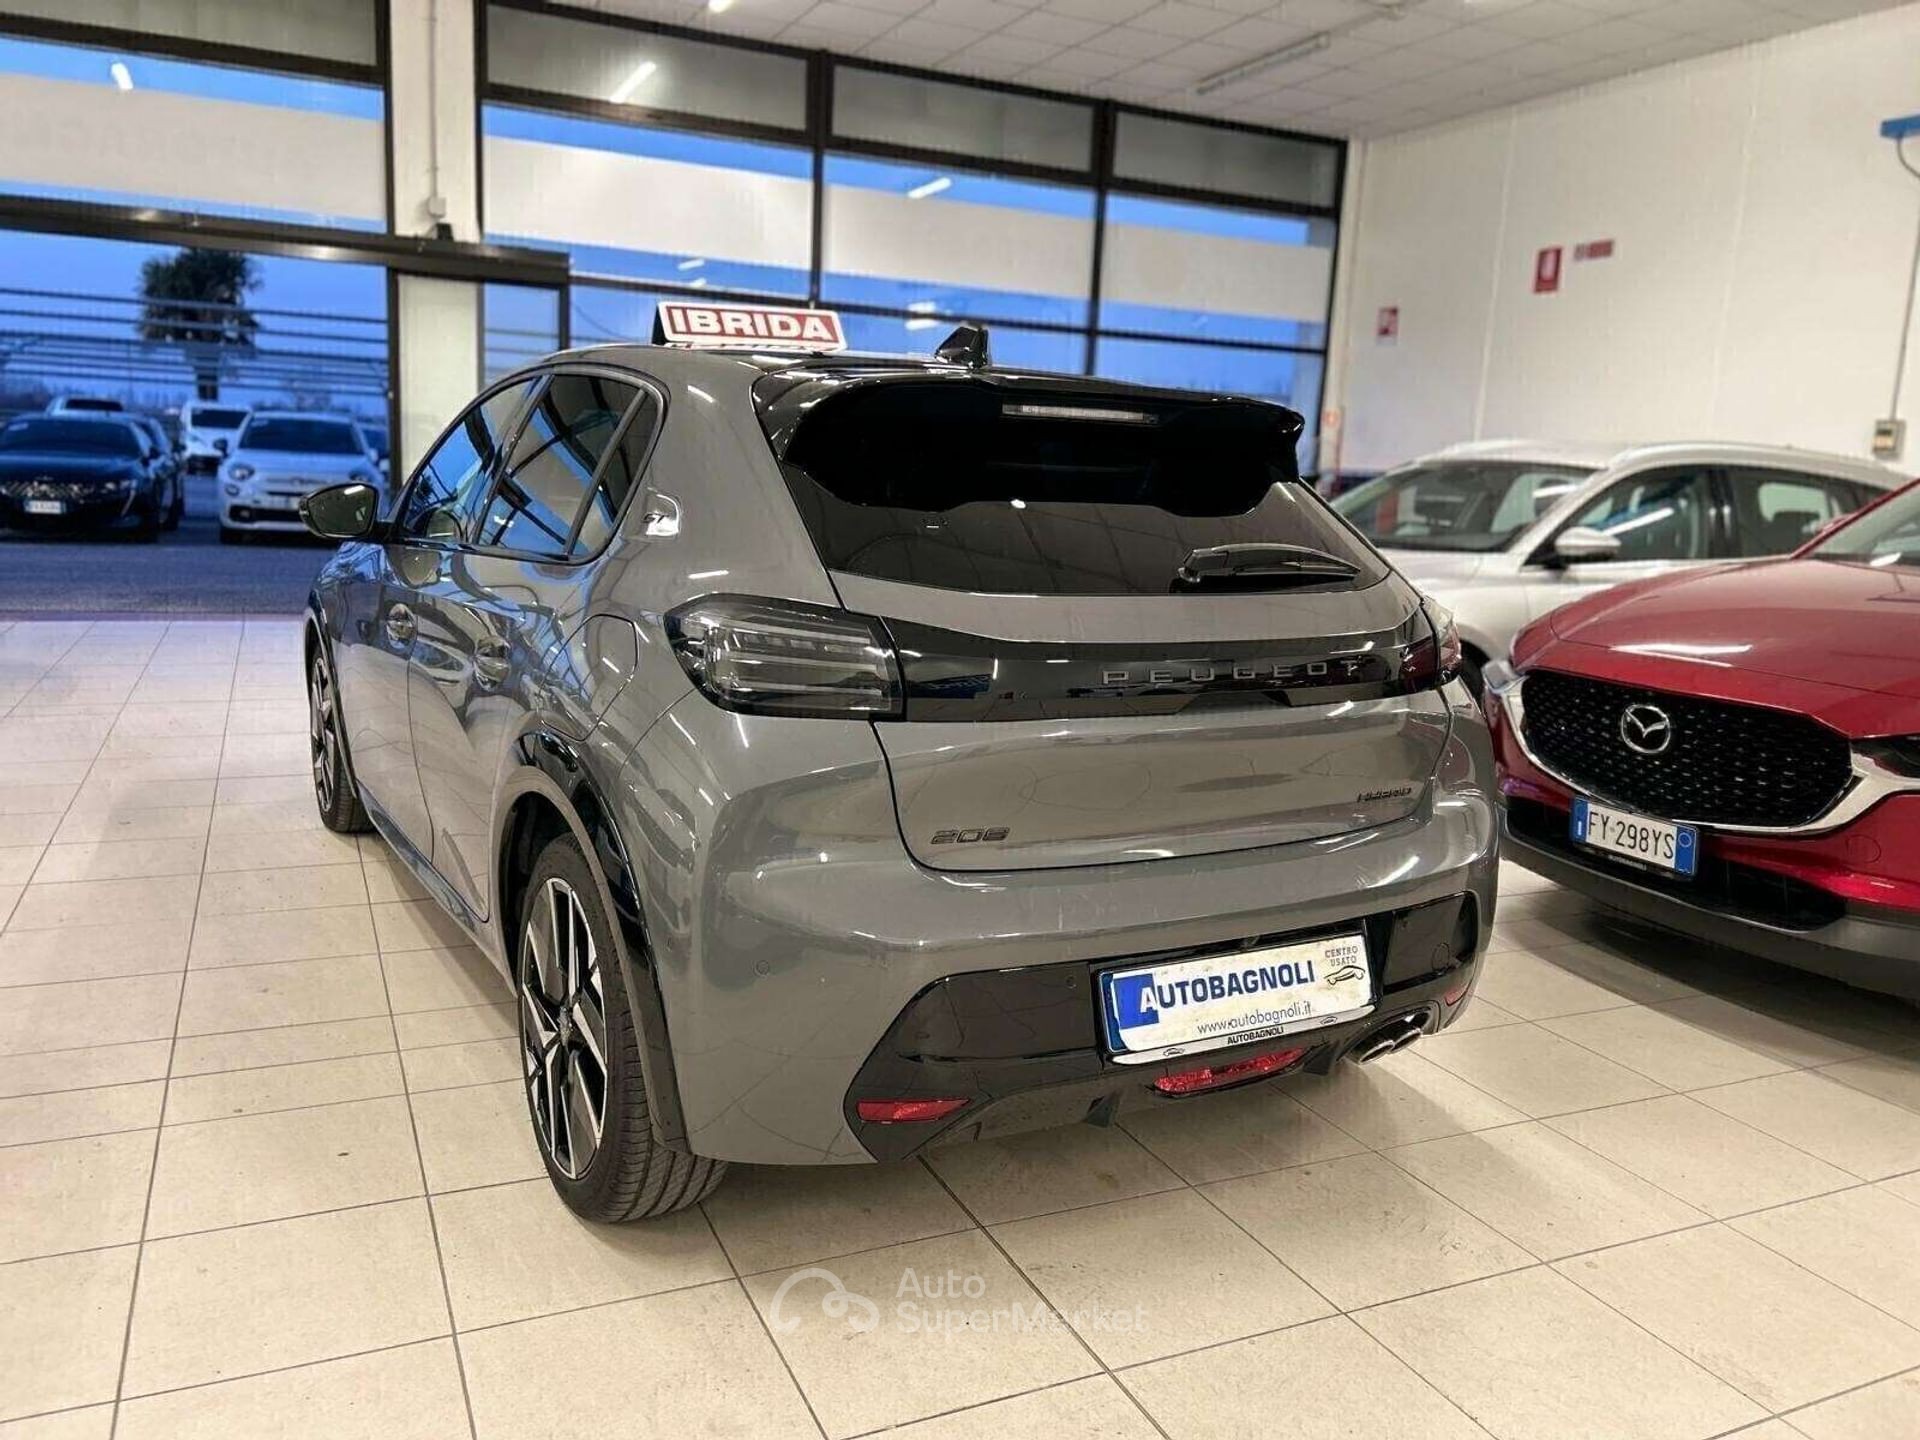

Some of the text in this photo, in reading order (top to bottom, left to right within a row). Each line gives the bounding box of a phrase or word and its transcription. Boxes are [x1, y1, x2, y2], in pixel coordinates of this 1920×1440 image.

[672, 308, 834, 341] IBRIDA
[642, 512, 670, 524] GT
[1103, 659, 1358, 684] PEUGEOT
[931, 826, 1010, 845] 208
[1588, 810, 1675, 860] FY 298YS
[1324, 945, 1359, 958] CENTRO
[1330, 955, 1358, 967] USATO
[1140, 960, 1316, 1014] AUTOBAGNOLI
[1197, 1000, 1312, 1035] www.autobagnoli.it
[1227, 1026, 1285, 1046] AUTOBAGNOLI
